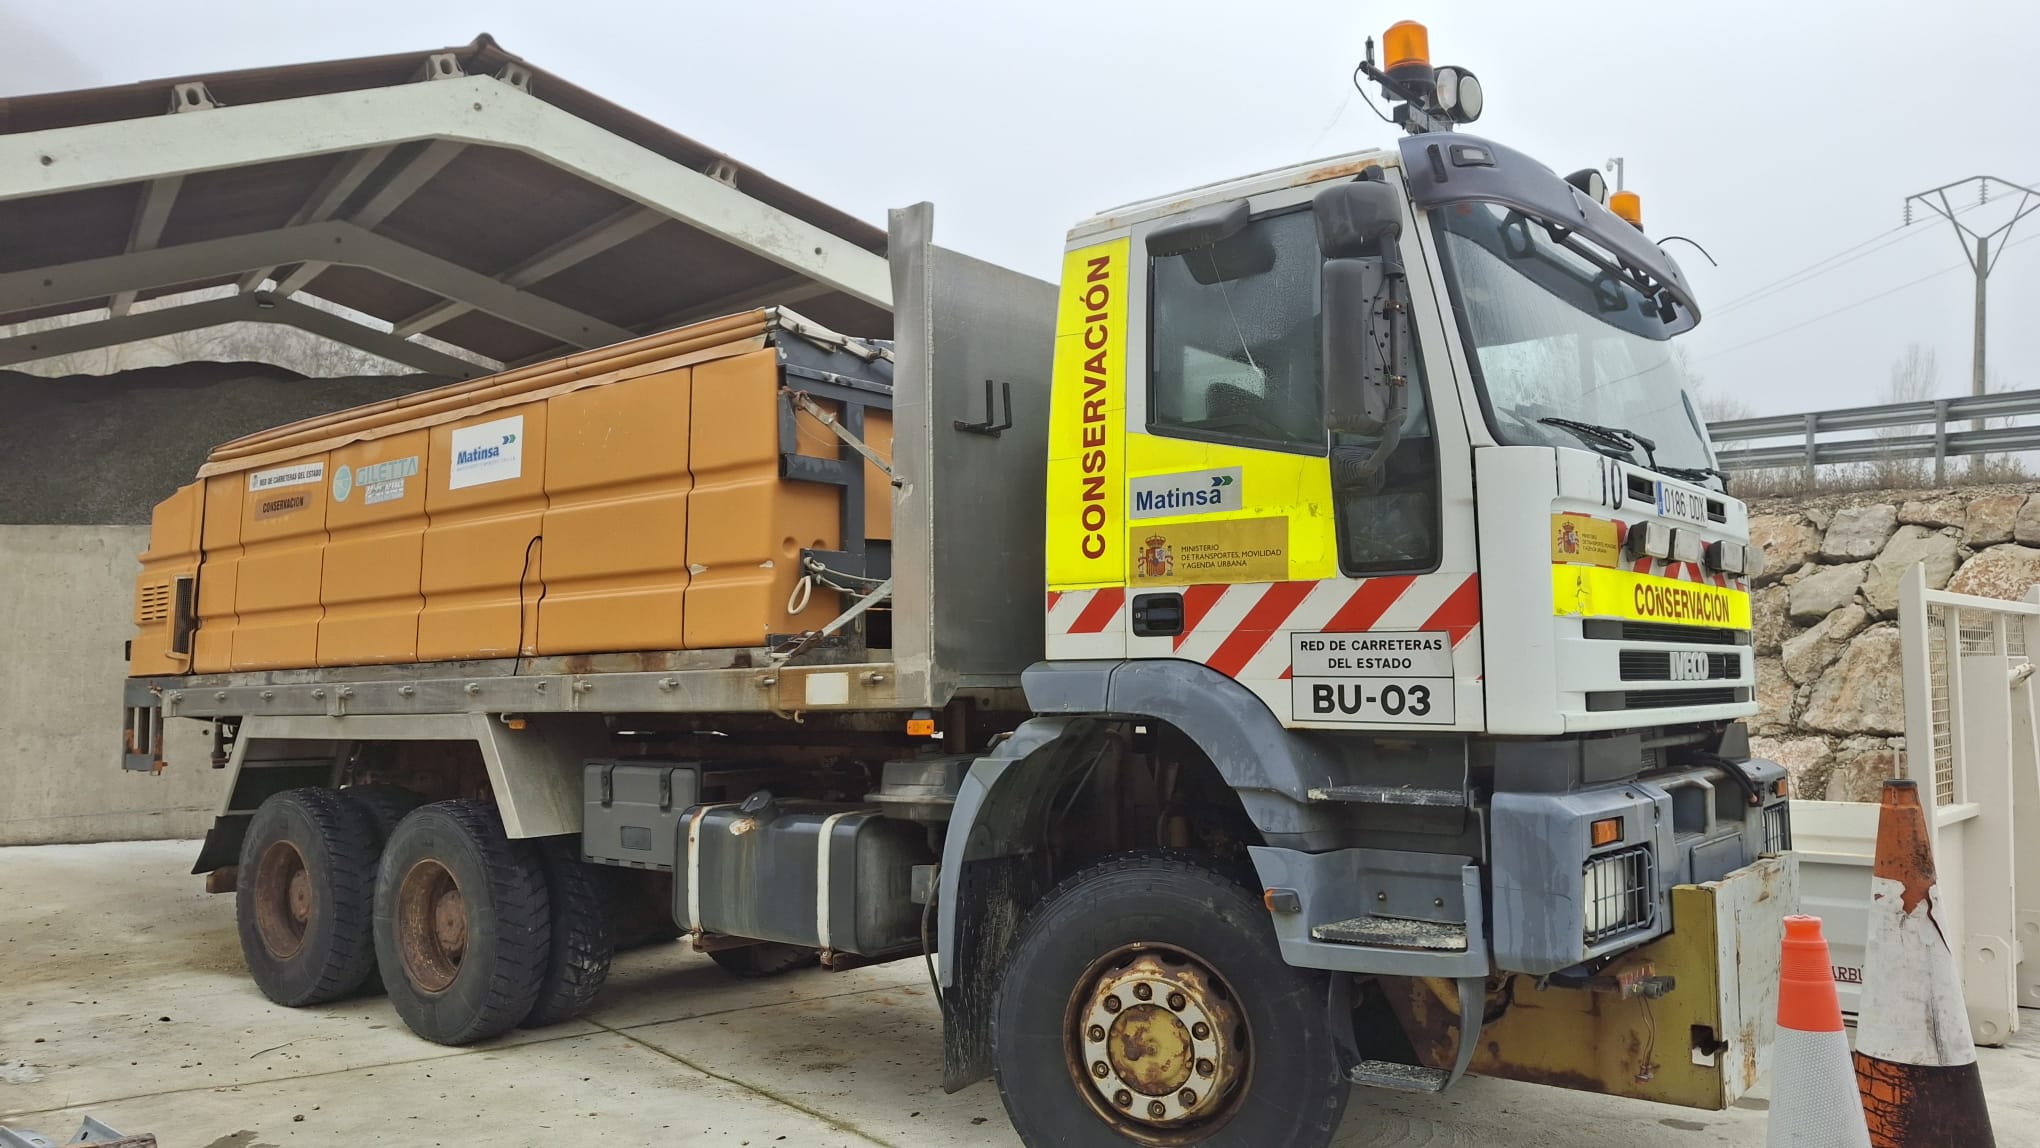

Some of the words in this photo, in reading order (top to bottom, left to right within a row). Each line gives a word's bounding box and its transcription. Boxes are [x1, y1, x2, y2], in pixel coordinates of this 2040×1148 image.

[1080, 255, 1110, 559] CONSERVACIÓN
[457, 446, 499, 465] Matinsa
[1136, 488, 1222, 511] Matinsa
[1664, 488, 1686, 516] 0186
[1689, 494, 1705, 522] DDX
[1181, 544, 1219, 553] MINISTERIO
[1192, 552, 1240, 561] TRANSPORTES,
[1242, 549, 1282, 558] MOVILIDAD
[1187, 561, 1216, 569] AGENDA
[1218, 560, 1247, 568] URBANA
[1300, 640, 1325, 651] RED
[1329, 640, 1346, 651] DE
[1351, 639, 1442, 650] CARRETERAS
[1328, 658, 1352, 669] DEL
[1357, 658, 1412, 669] ESTADO
[1669, 651, 1710, 680] IVECO
[1313, 684, 1431, 716] BU-03
